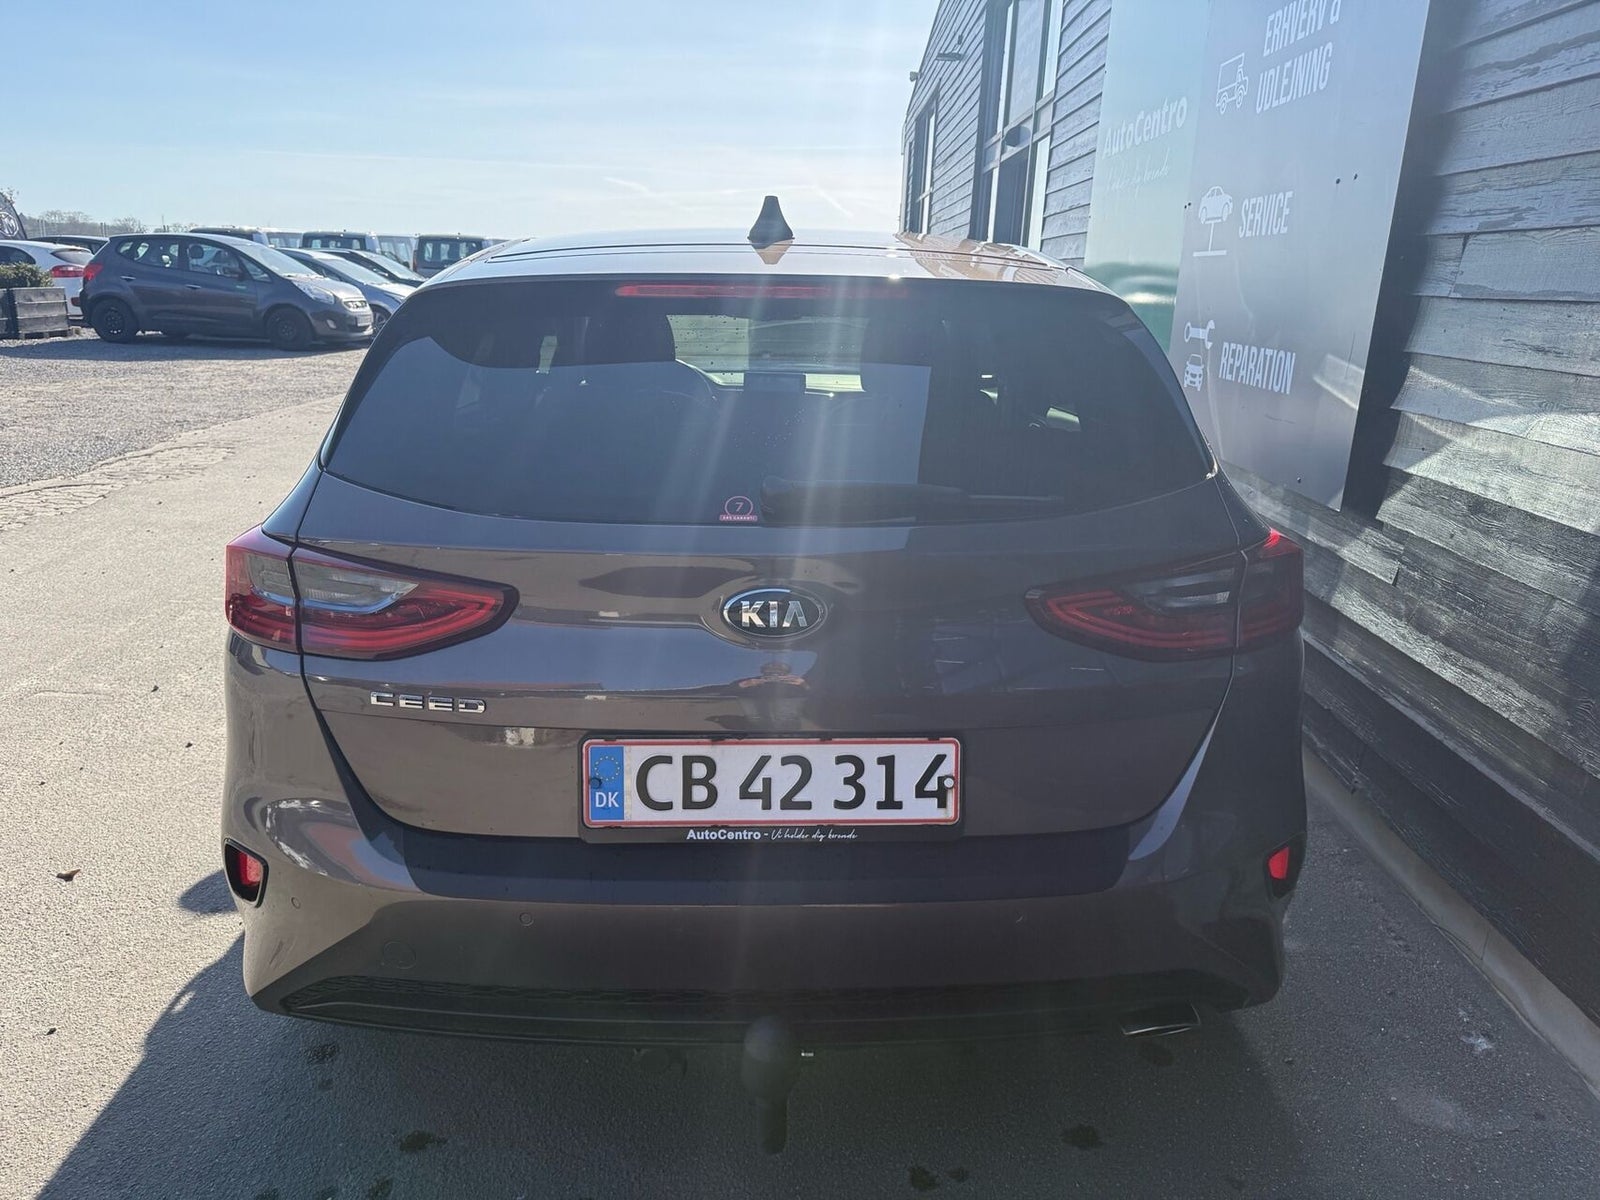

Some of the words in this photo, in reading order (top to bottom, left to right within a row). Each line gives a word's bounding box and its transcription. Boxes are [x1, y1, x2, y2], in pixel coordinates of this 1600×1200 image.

[1263, 0, 1327, 57] ERHVERV
[1255, 41, 1334, 114] UDLEJNING
[1102, 96, 1187, 159] AutoCentro
[1239, 190, 1294, 239] SERVICE
[1218, 341, 1296, 395] REPARATION
[734, 501, 744, 512] 7
[740, 600, 808, 628] KIA
[370, 691, 486, 714] CEED
[594, 791, 619, 808] DK
[635, 754, 718, 811] CB
[738, 754, 813, 811] 42
[833, 753, 950, 810] 314
[686, 828, 761, 840] AutoCentro
[771, 828, 782, 840] Vi
[783, 828, 809, 840] holder
[811, 828, 825, 842] dig
